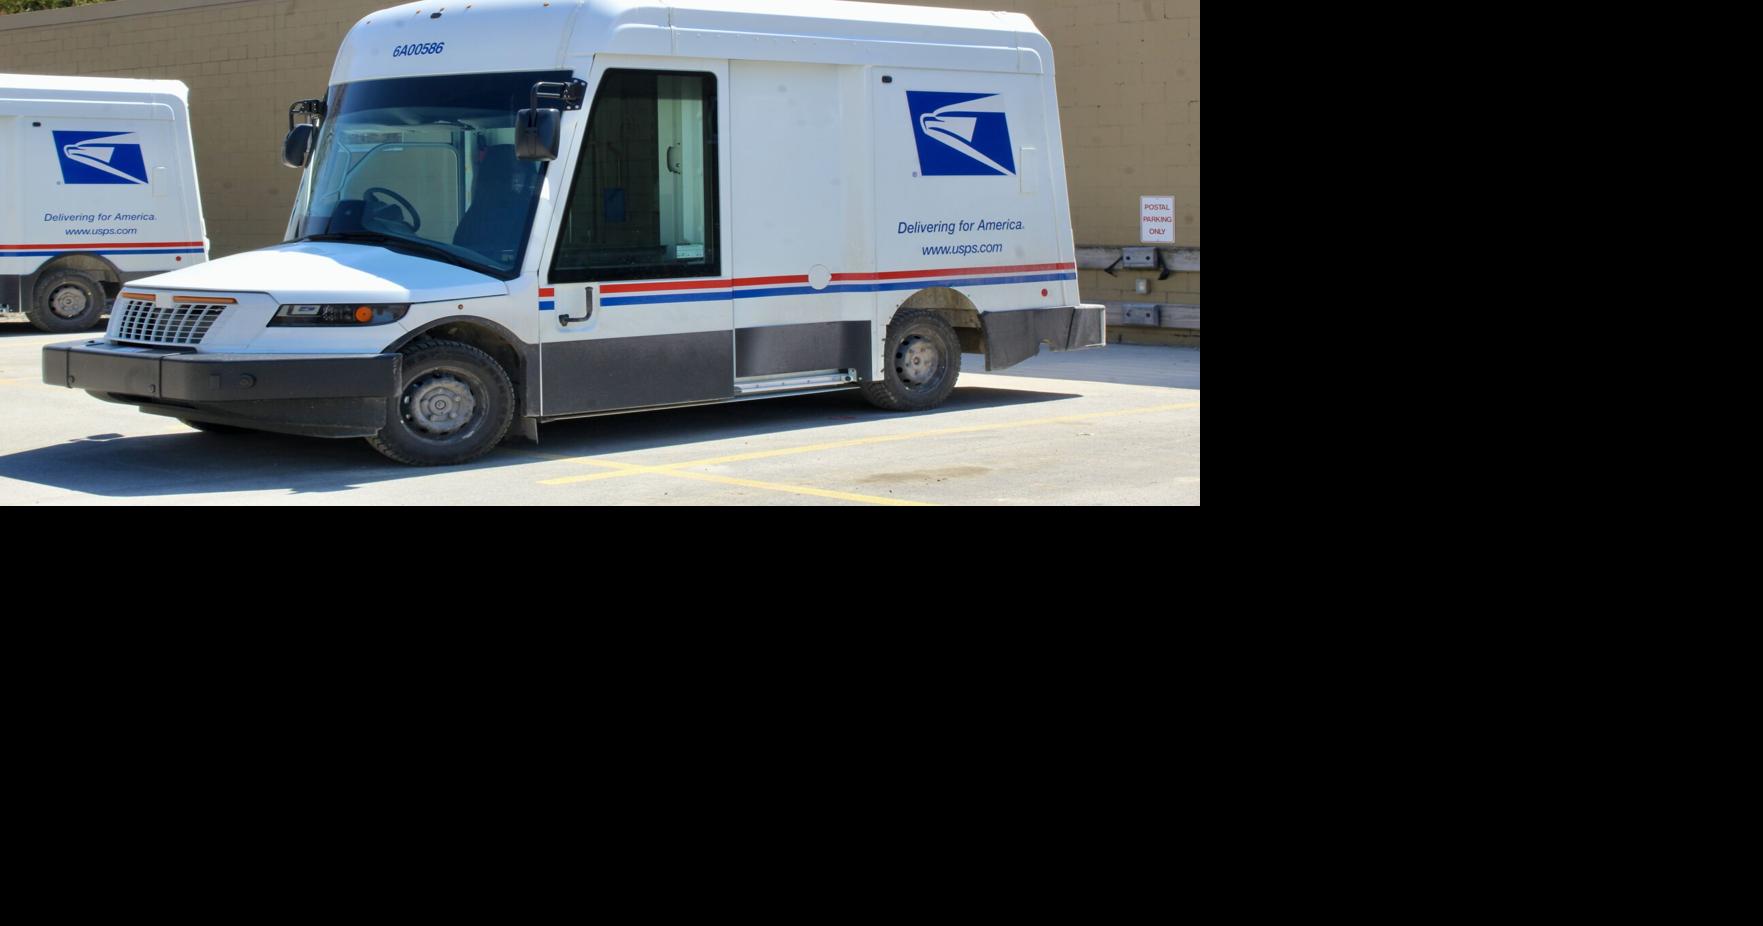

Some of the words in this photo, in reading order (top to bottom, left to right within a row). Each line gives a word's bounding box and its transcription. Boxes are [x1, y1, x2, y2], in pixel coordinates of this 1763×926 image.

[392, 41, 445, 57] 6A00586
[44, 213, 95, 223] Delivering
[98, 213, 112, 221] for
[65, 228, 137, 236] www.usps.com
[897, 221, 956, 235] Delivering
[959, 220, 975, 231] for
[922, 243, 1003, 256] www.usps.com
